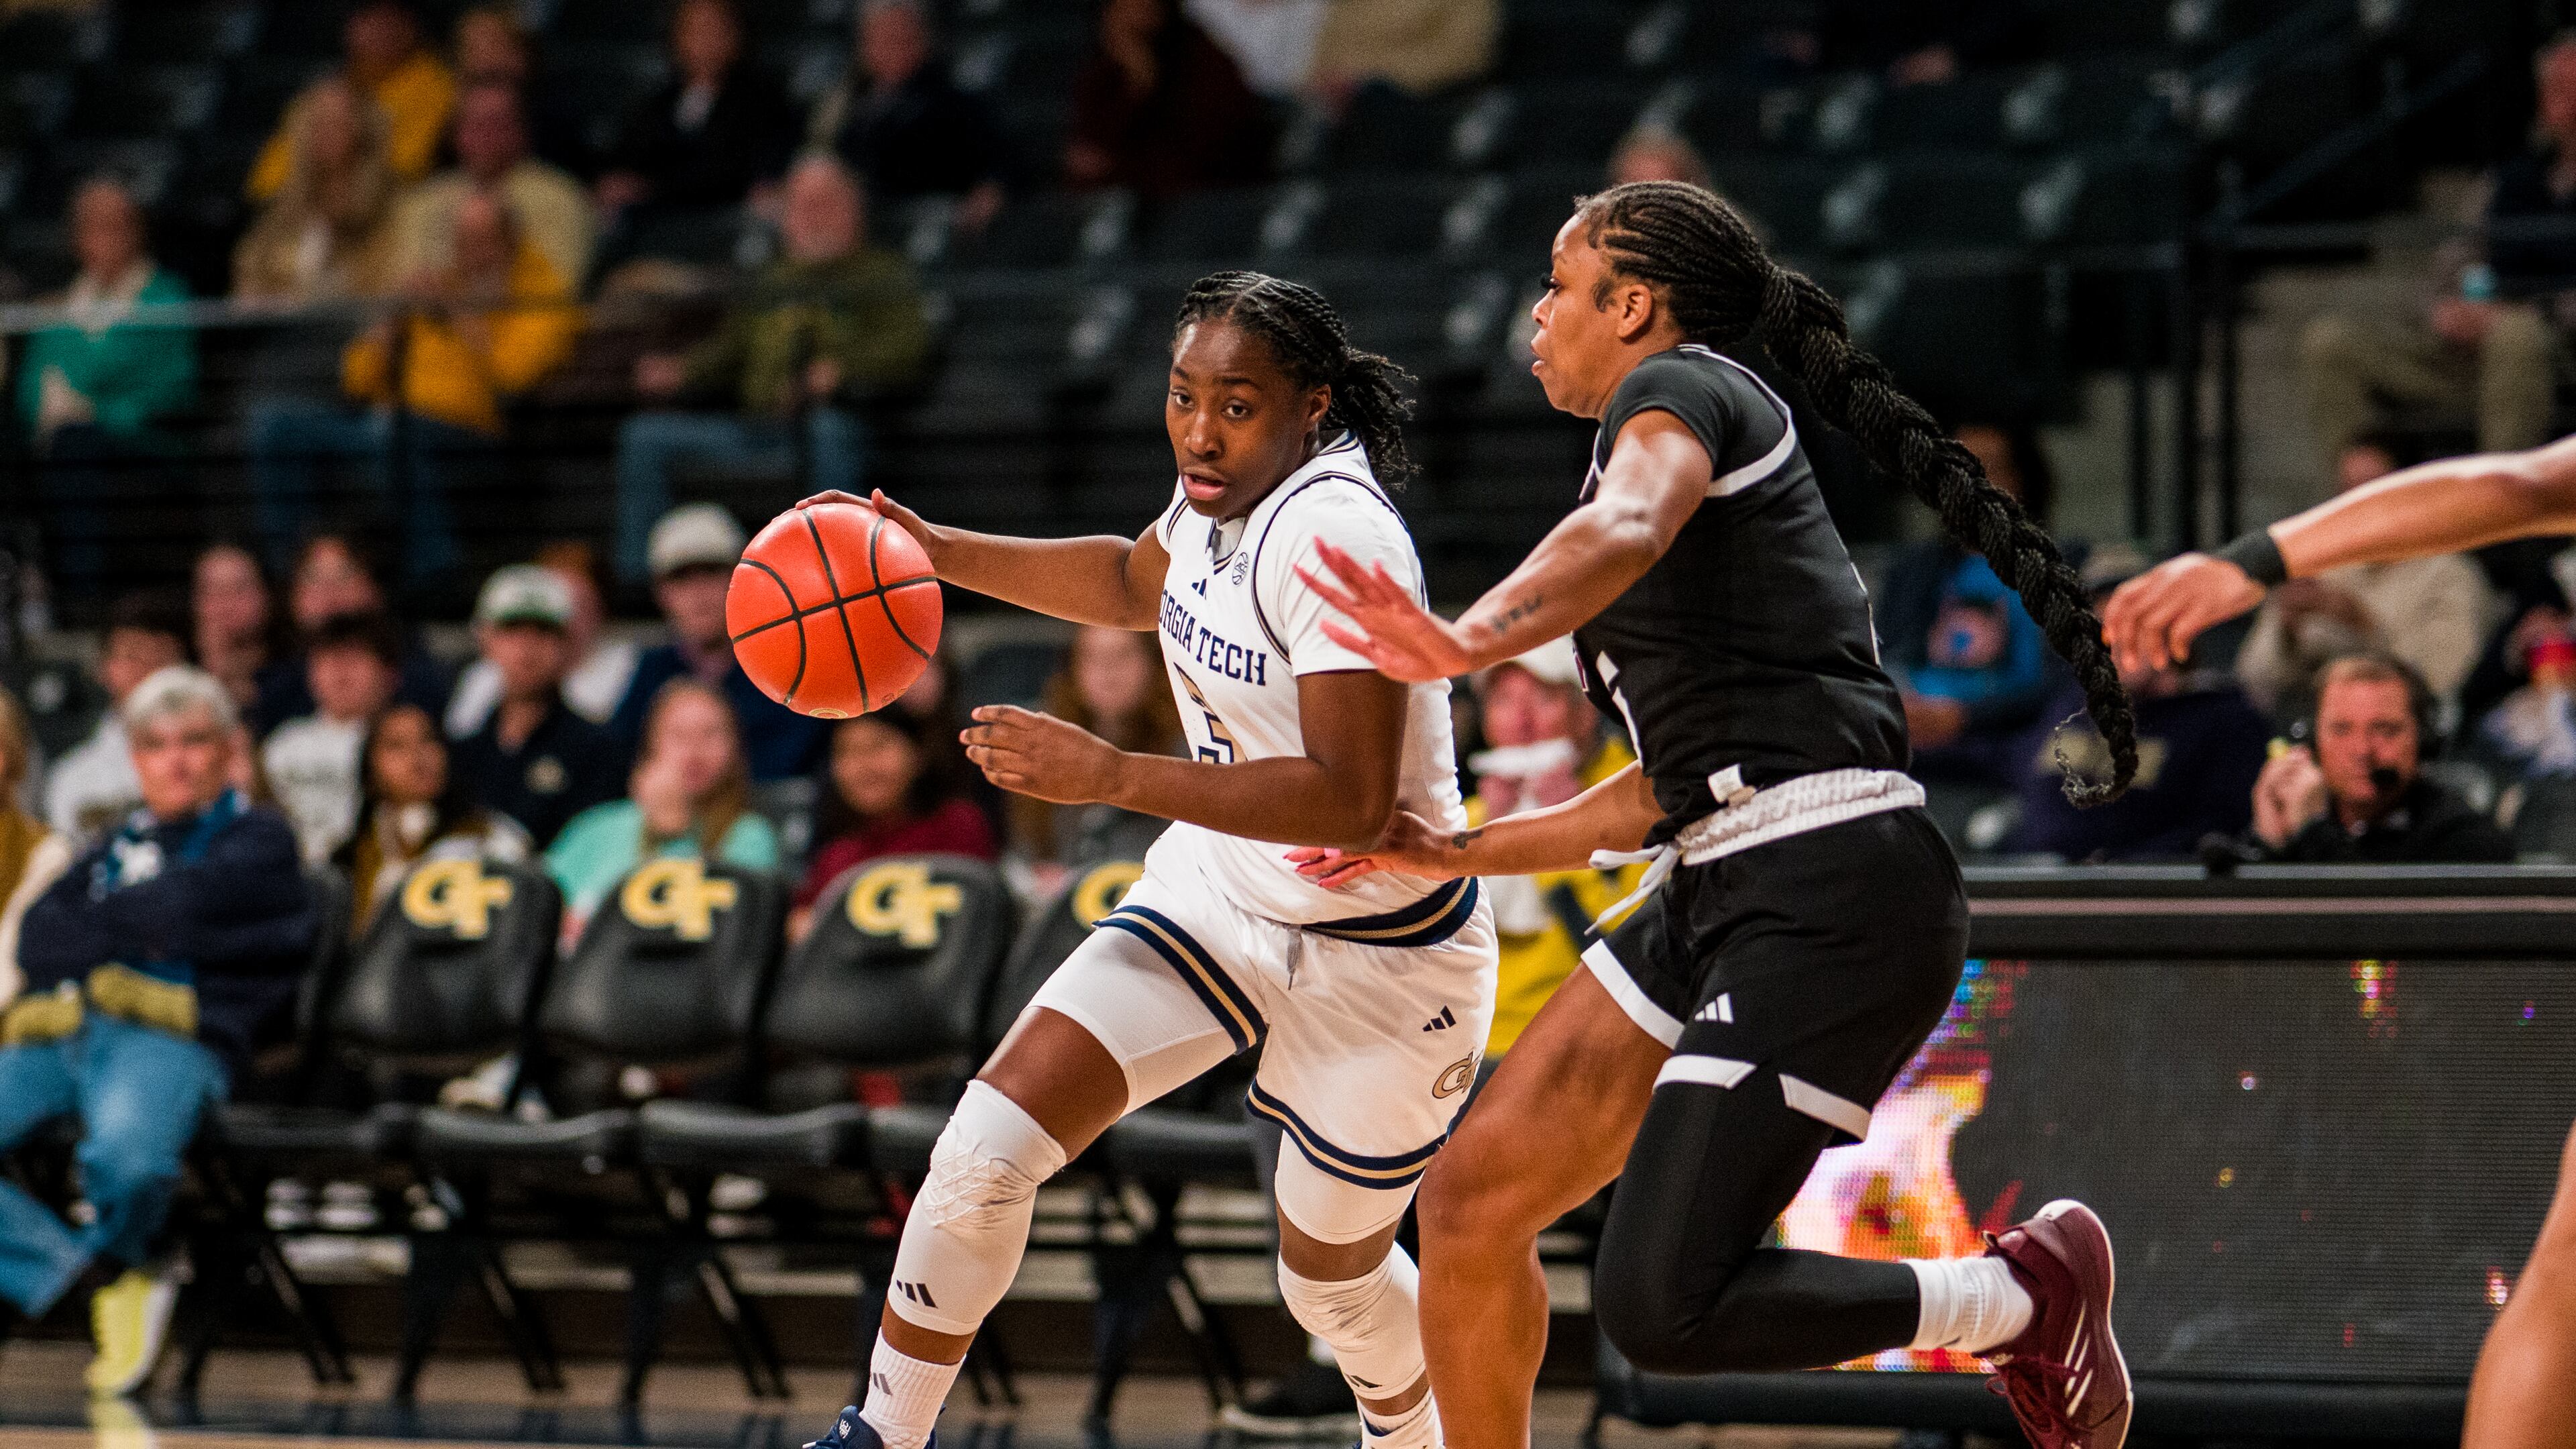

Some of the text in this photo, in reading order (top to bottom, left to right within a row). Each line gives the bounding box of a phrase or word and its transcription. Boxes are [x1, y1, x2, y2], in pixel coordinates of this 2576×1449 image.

[1159, 588, 1267, 686] ORGIA TECH
[1075, 861, 1145, 928] G
